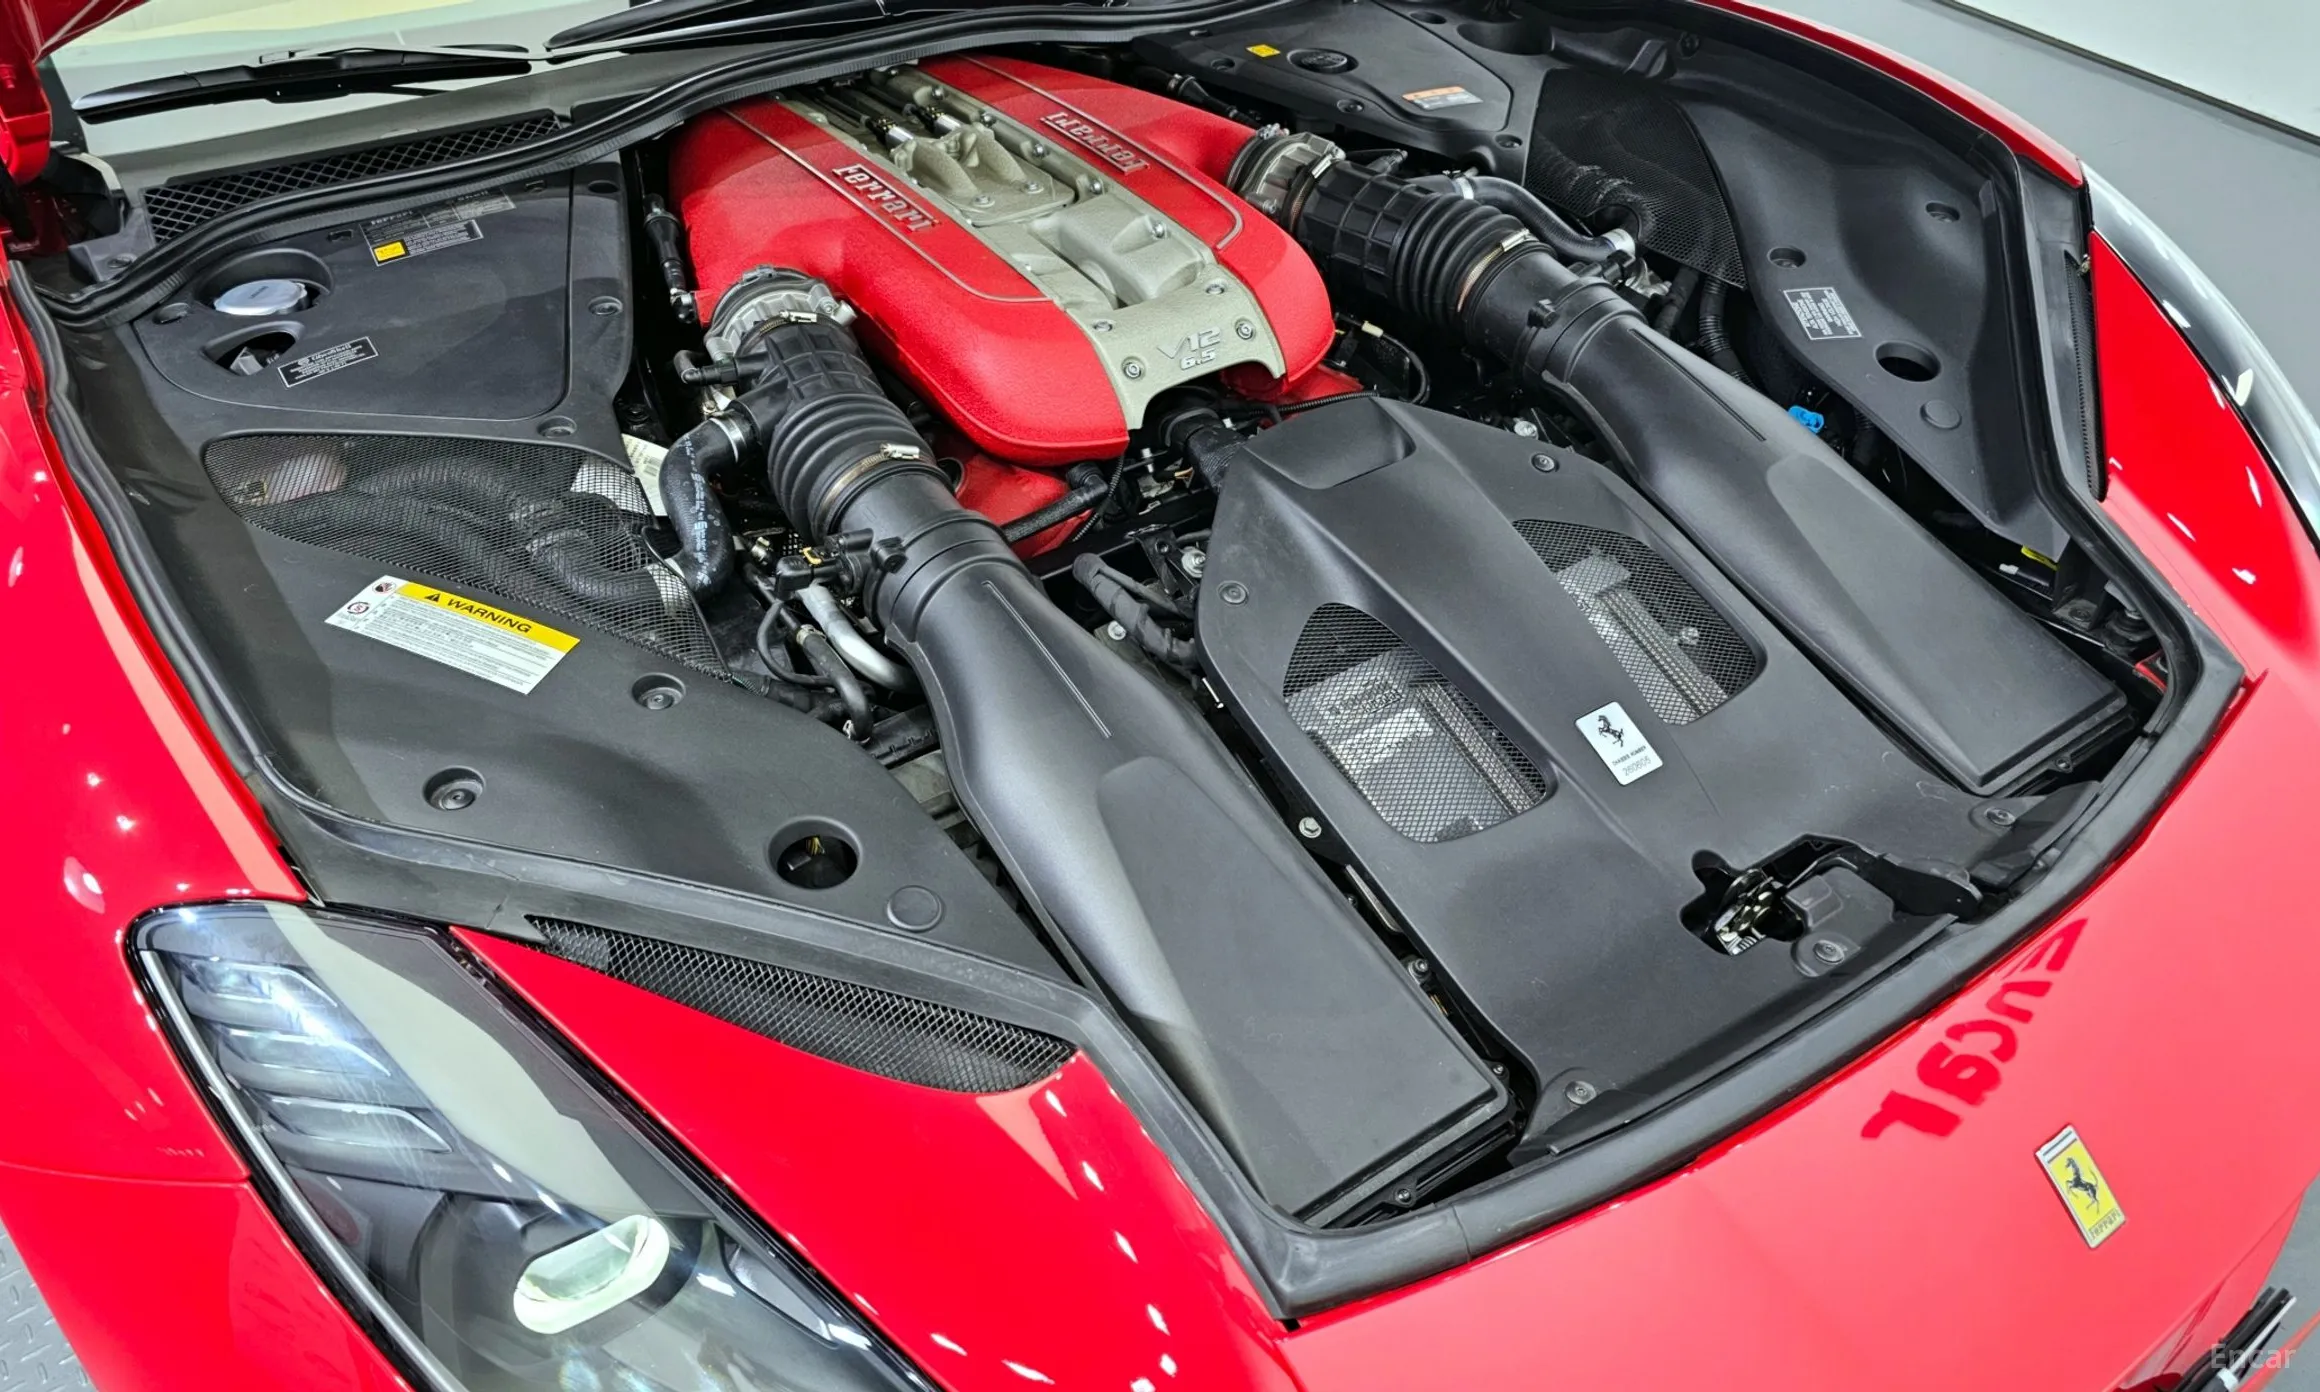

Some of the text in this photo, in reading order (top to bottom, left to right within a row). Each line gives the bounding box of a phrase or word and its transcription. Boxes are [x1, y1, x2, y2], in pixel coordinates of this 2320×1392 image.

[1040, 112, 1150, 175] Ferrari
[832, 163, 941, 231] Ferrari
[1157, 326, 1221, 359] V12
[1180, 348, 1216, 370] 6.5
[447, 598, 532, 634] WARNING
[2089, 1208, 2121, 1240] Ferrari
